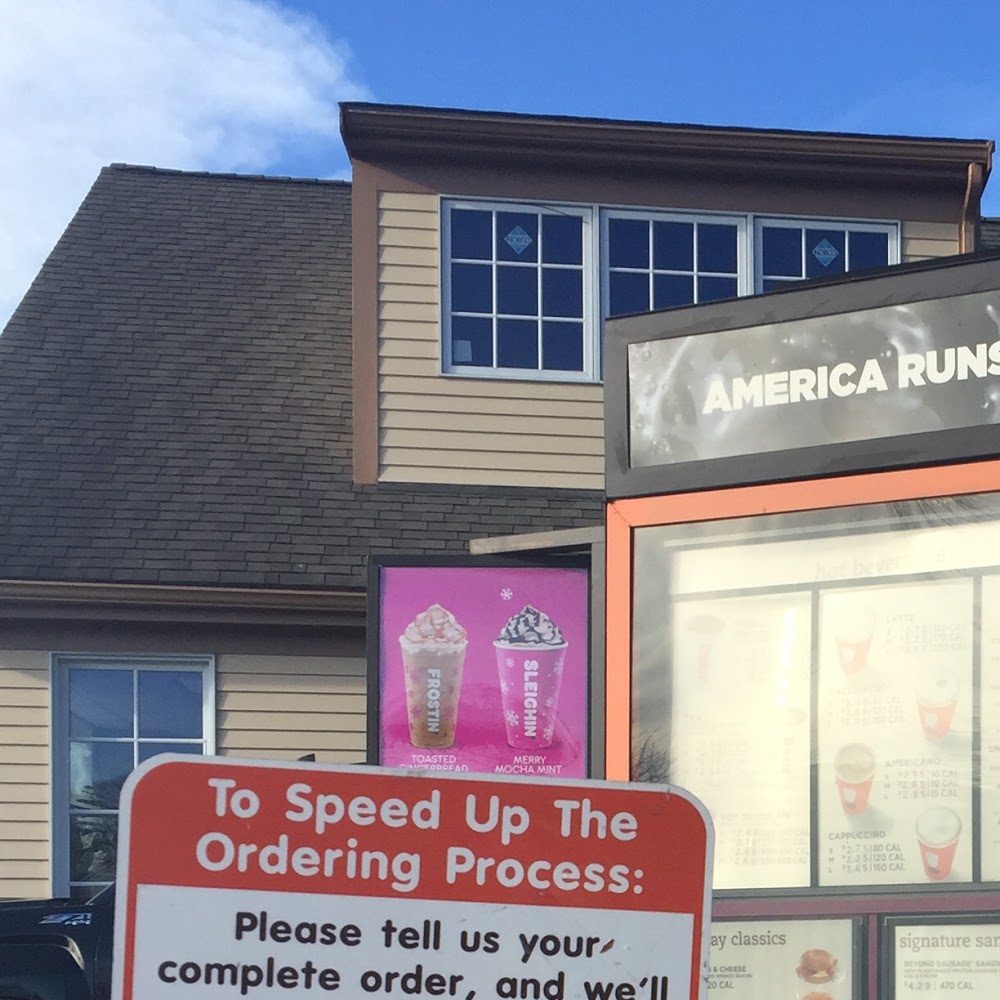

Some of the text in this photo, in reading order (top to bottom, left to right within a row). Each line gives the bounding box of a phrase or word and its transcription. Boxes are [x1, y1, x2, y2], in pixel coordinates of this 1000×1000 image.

[702, 358, 888, 415] AMERICA
[411, 755, 456, 764] TOASTED
[495, 765, 562, 774] MOCHA MINT
[514, 756, 546, 764] MERRY
[208, 778, 638, 844] To Speed Up The
[829, 831, 886, 840] CAPPUCCINO
[195, 832, 644, 894] Ordering Process:
[234, 911, 600, 963] Please tell us your
[711, 930, 786, 950] ay classics
[899, 933, 972, 952] signature
[157, 959, 341, 995] complete
